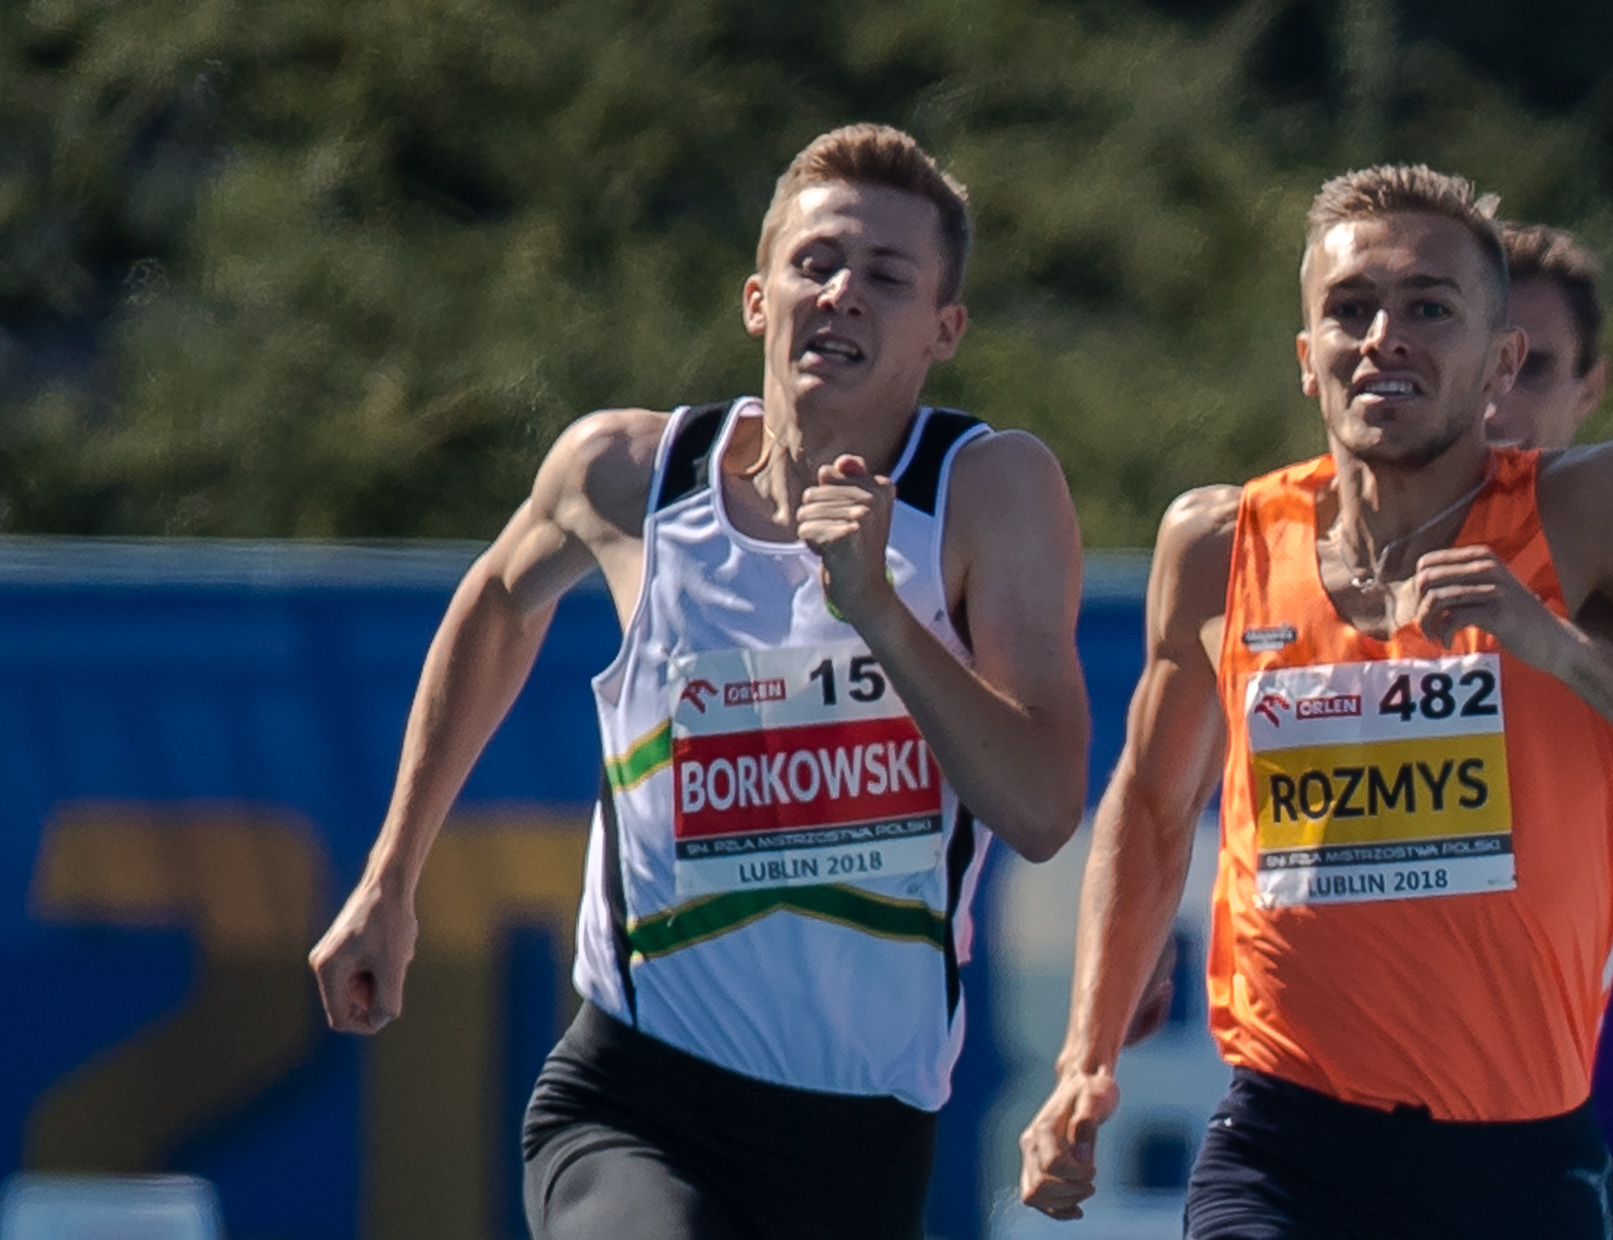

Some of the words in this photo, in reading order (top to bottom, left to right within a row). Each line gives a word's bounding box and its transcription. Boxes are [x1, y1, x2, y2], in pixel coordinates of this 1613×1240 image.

[809, 656, 887, 706] 15
[1379, 669, 1499, 722] 482
[1299, 696, 1357, 717] ORLEN
[680, 739, 929, 814] BORKOWSKI
[1269, 757, 1489, 823] ROZMYS
[738, 858, 819, 883] LUBLIN
[827, 851, 883, 875] 2018
[1393, 869, 1448, 892] 2018
